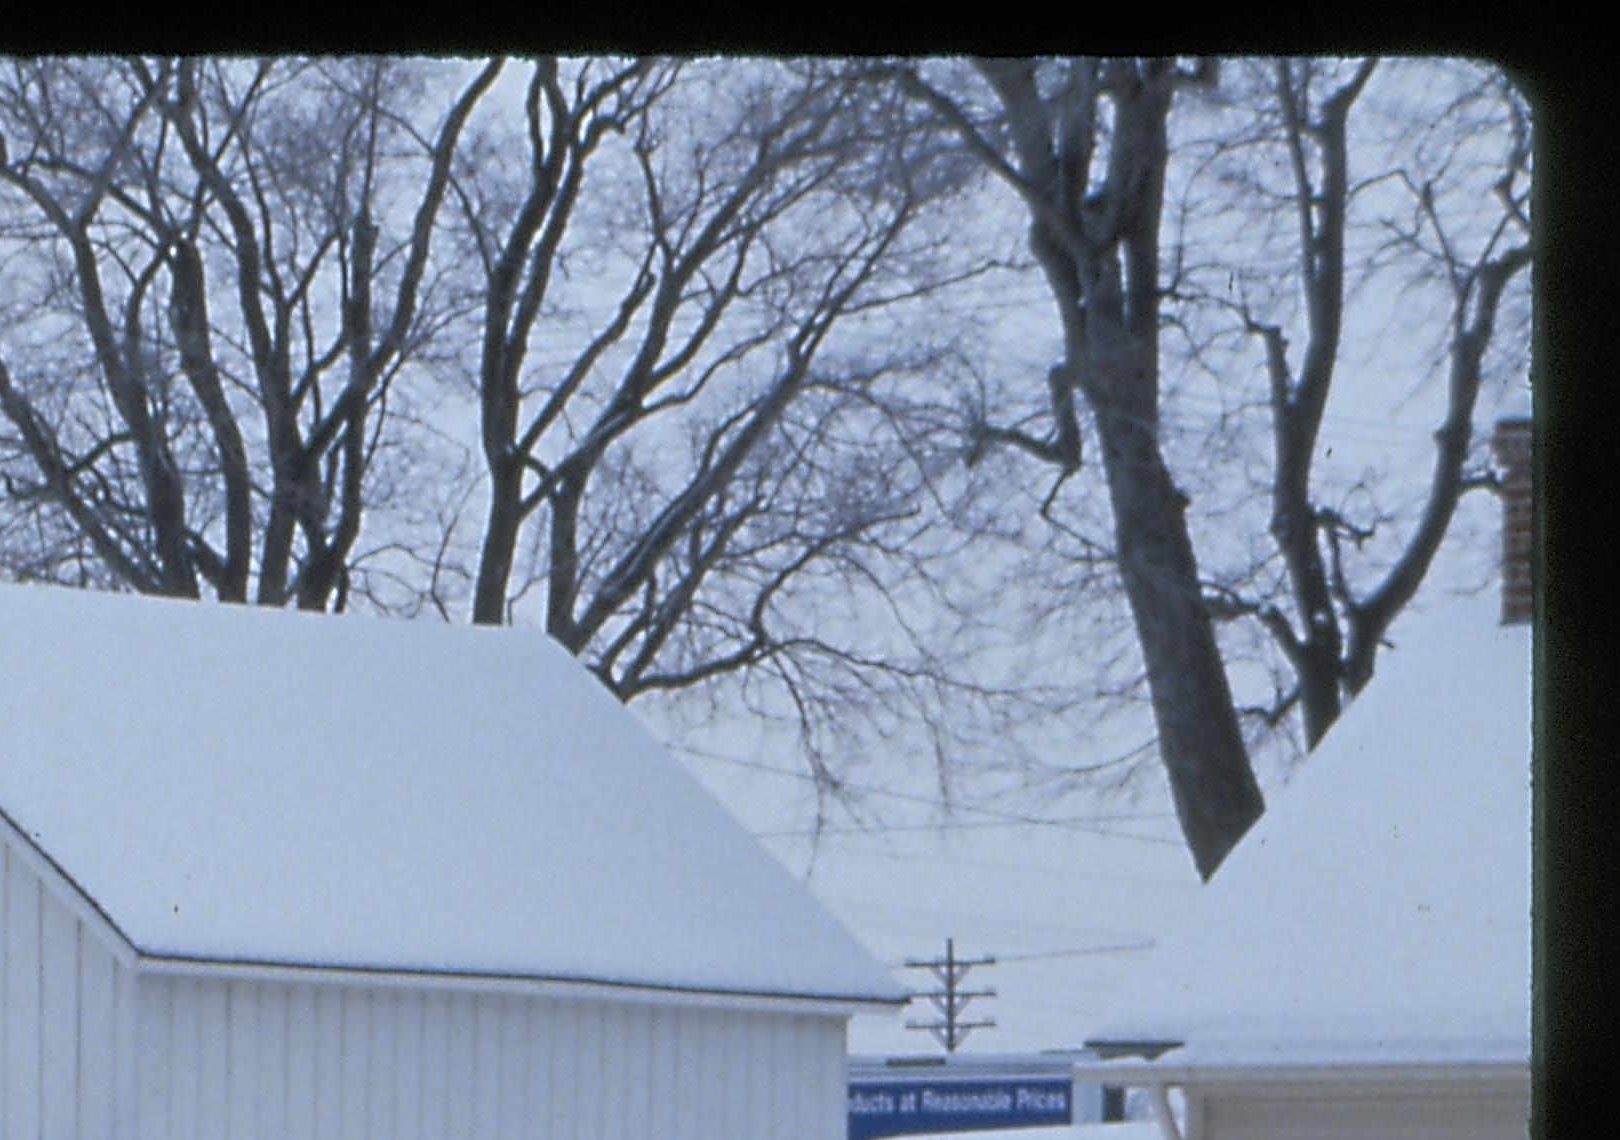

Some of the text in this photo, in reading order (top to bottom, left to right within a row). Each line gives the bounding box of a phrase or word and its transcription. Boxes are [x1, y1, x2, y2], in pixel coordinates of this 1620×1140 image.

[900, 1093, 916, 1112] at
[923, 1090, 1011, 1112] Reasonable
[1018, 1088, 1066, 1110] Prices
